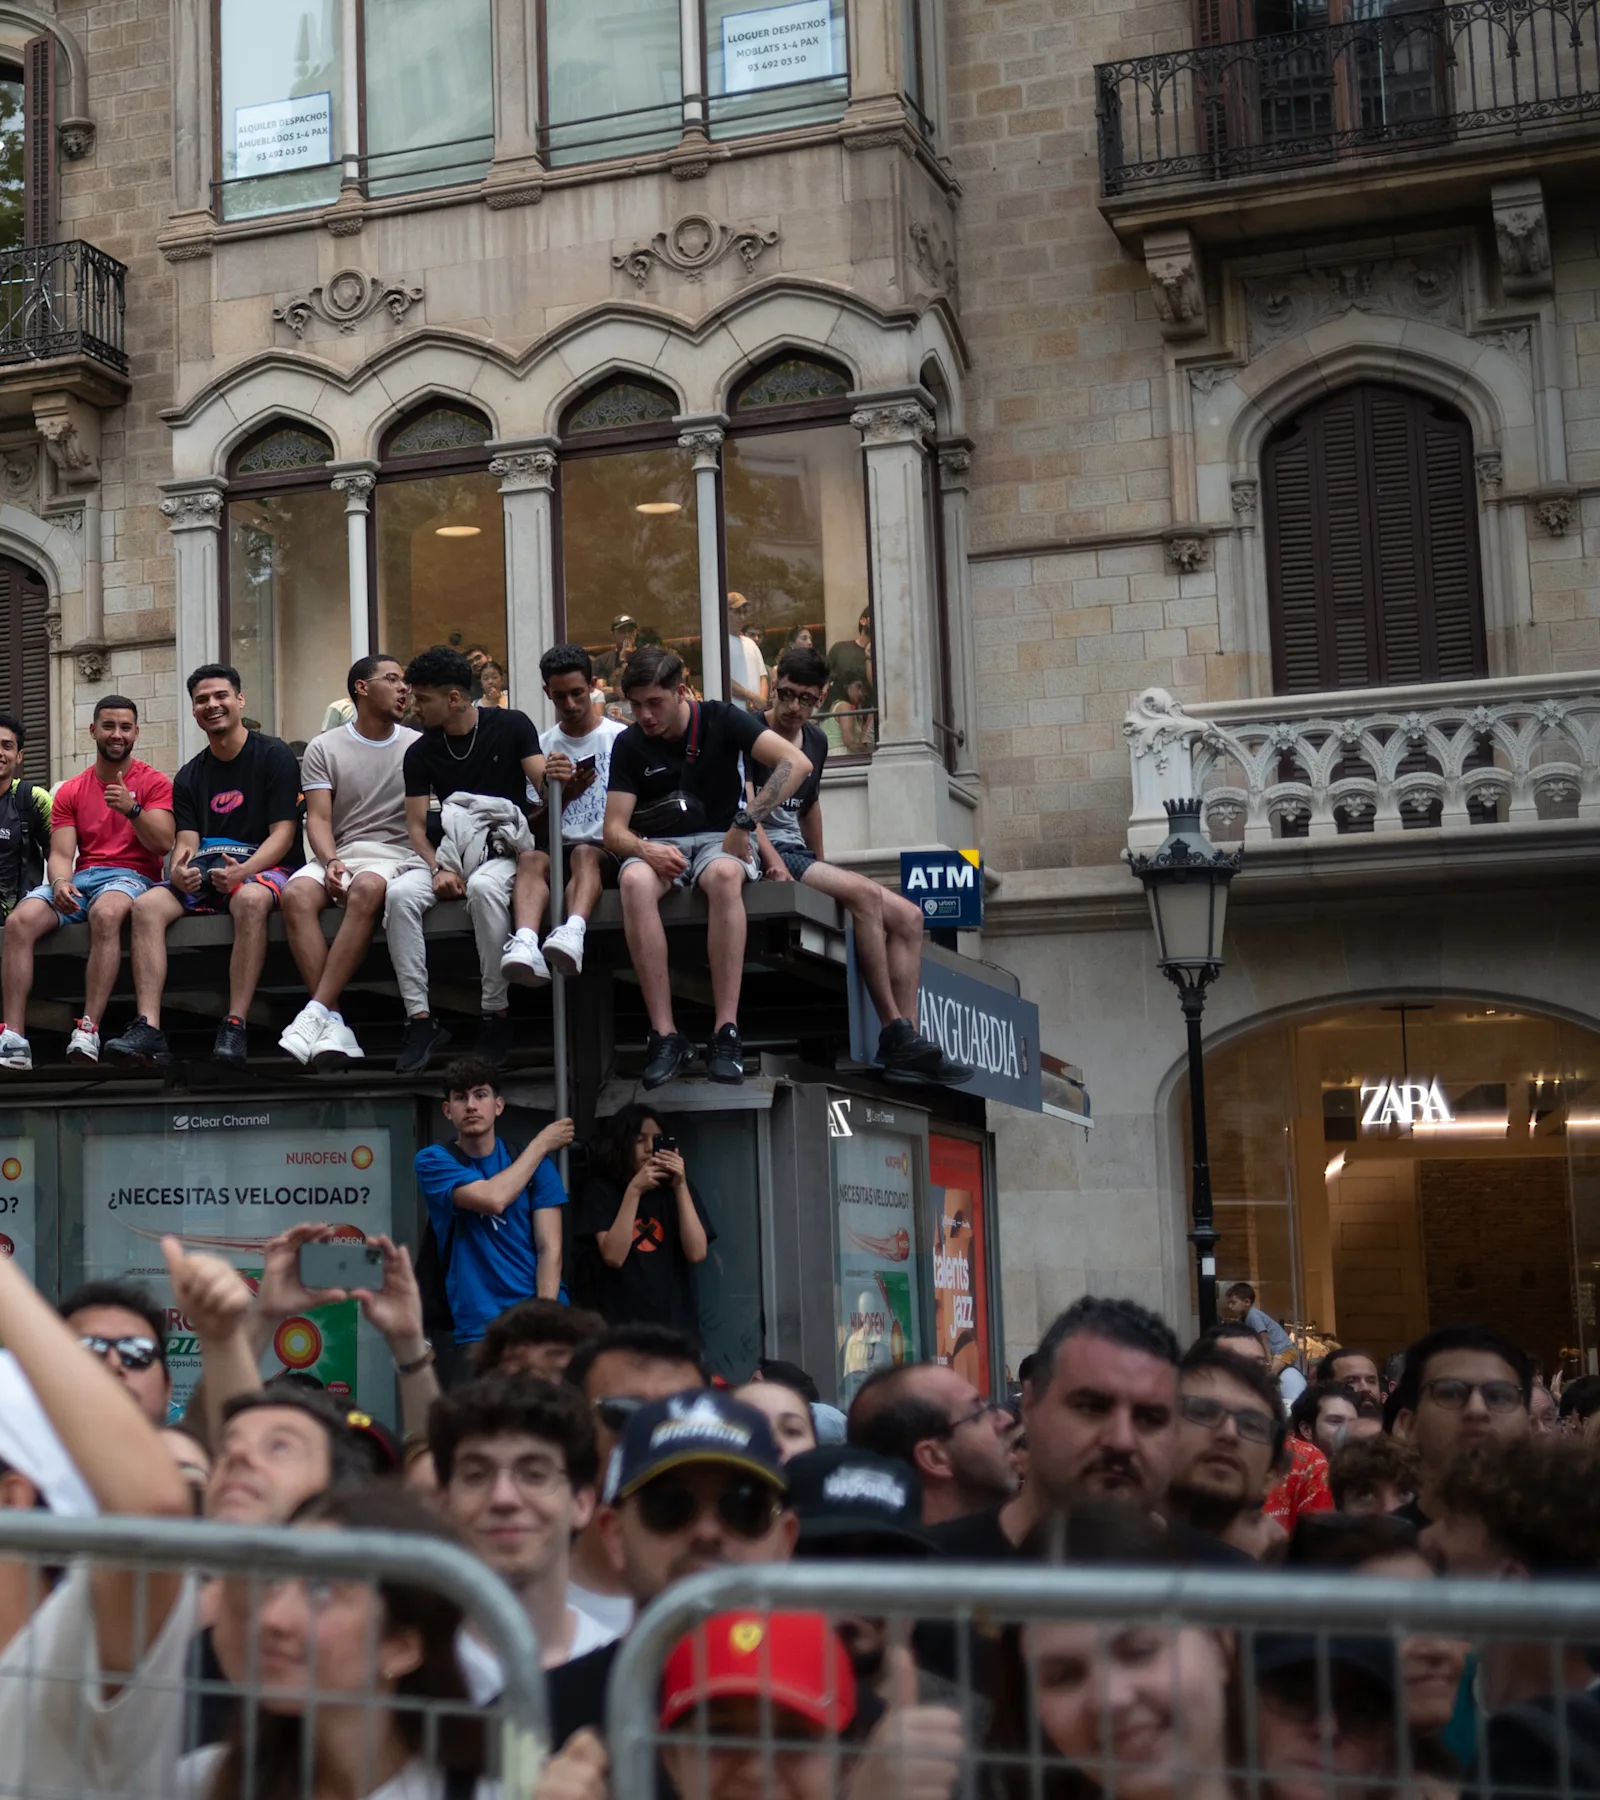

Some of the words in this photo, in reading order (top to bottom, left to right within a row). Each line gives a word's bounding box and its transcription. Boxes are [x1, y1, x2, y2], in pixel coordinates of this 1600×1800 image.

[727, 29, 770, 43] LLOGUER
[772, 18, 827, 36] DESPATXOS
[736, 43, 780, 58] MOBLATS
[782, 41, 798, 51] 1-4
[800, 36, 820, 47] PAX
[747, 63, 759, 72] 93
[762, 59, 779, 70] 492
[781, 57, 793, 66] 03
[794, 55, 807, 64] 50
[238, 120, 278, 134] ALQUILER
[279, 111, 328, 126] DESPACHOS
[238, 133, 294, 149] AMUEBLADOS
[296, 131, 310, 139] 1-4
[311, 126, 328, 136] PAX
[256, 152, 267, 161] 93
[268, 149, 283, 159] 492
[285, 146, 296, 156] 03
[297, 145, 308, 154] 50
[907, 866, 974, 890] ATM
[917, 985, 1021, 1079] ANGUARDIA
[1360, 1083, 1457, 1125] ZARA
[190, 1115, 220, 1129] Clear
[222, 1113, 270, 1127] Channel
[286, 1151, 347, 1165] NUROFEN
[108, 1187, 229, 1210] ¿NECESITAS
[234, 1187, 371, 1205] VELOCIDAD?
[933, 1244, 970, 1292] talents
[949, 1294, 974, 1339] jazz
